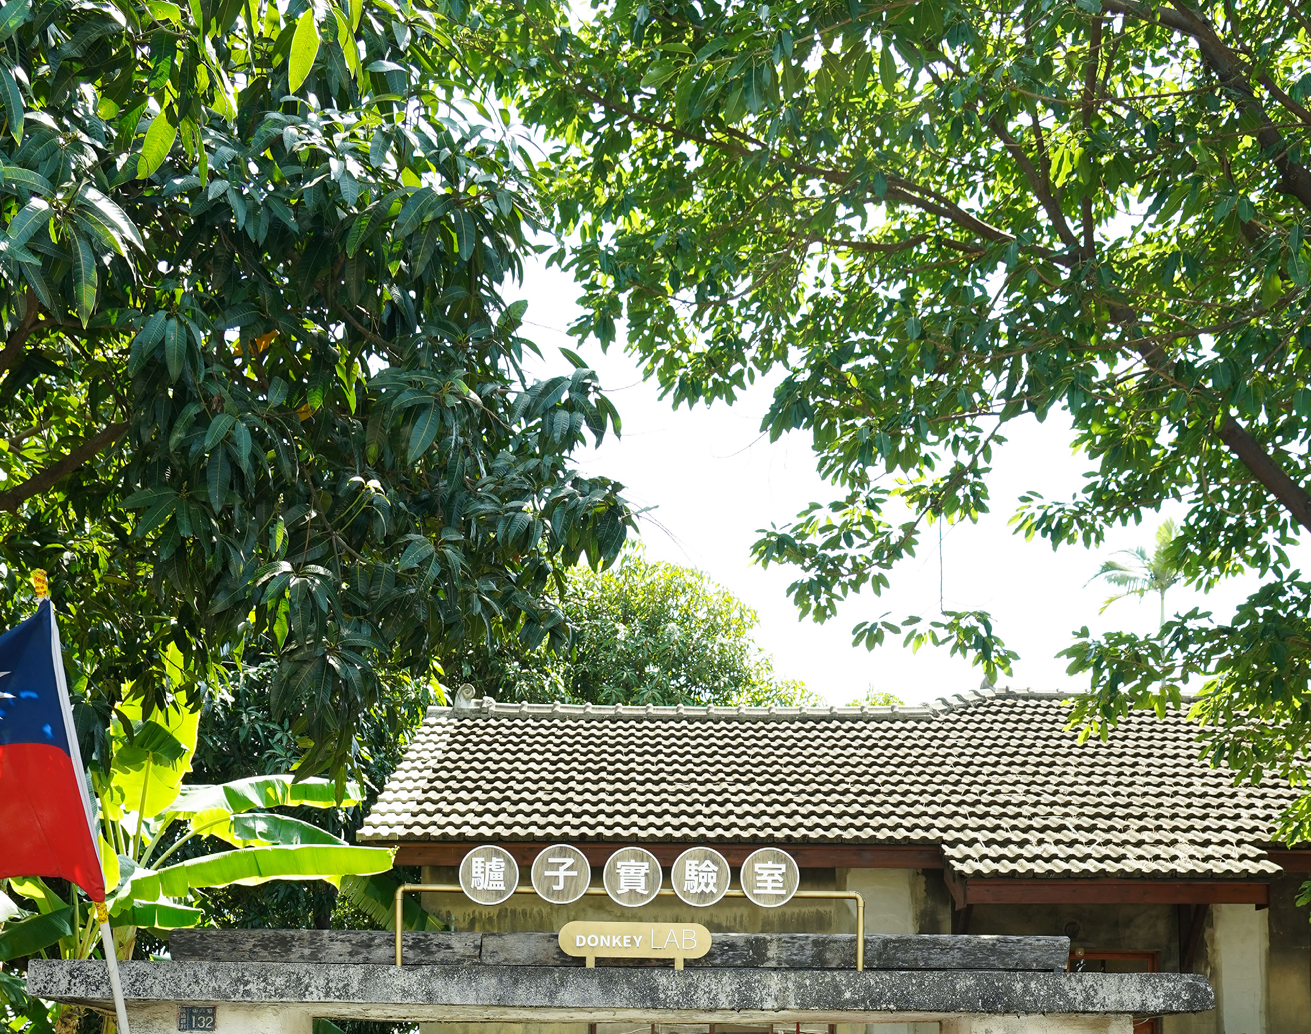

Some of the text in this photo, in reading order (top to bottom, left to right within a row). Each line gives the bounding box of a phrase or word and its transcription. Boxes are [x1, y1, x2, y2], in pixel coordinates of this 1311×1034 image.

[471, 857, 787, 895] 驢子實驗室
[575, 928, 698, 950] DONKEY LAB
[192, 1015, 214, 1029] 132
